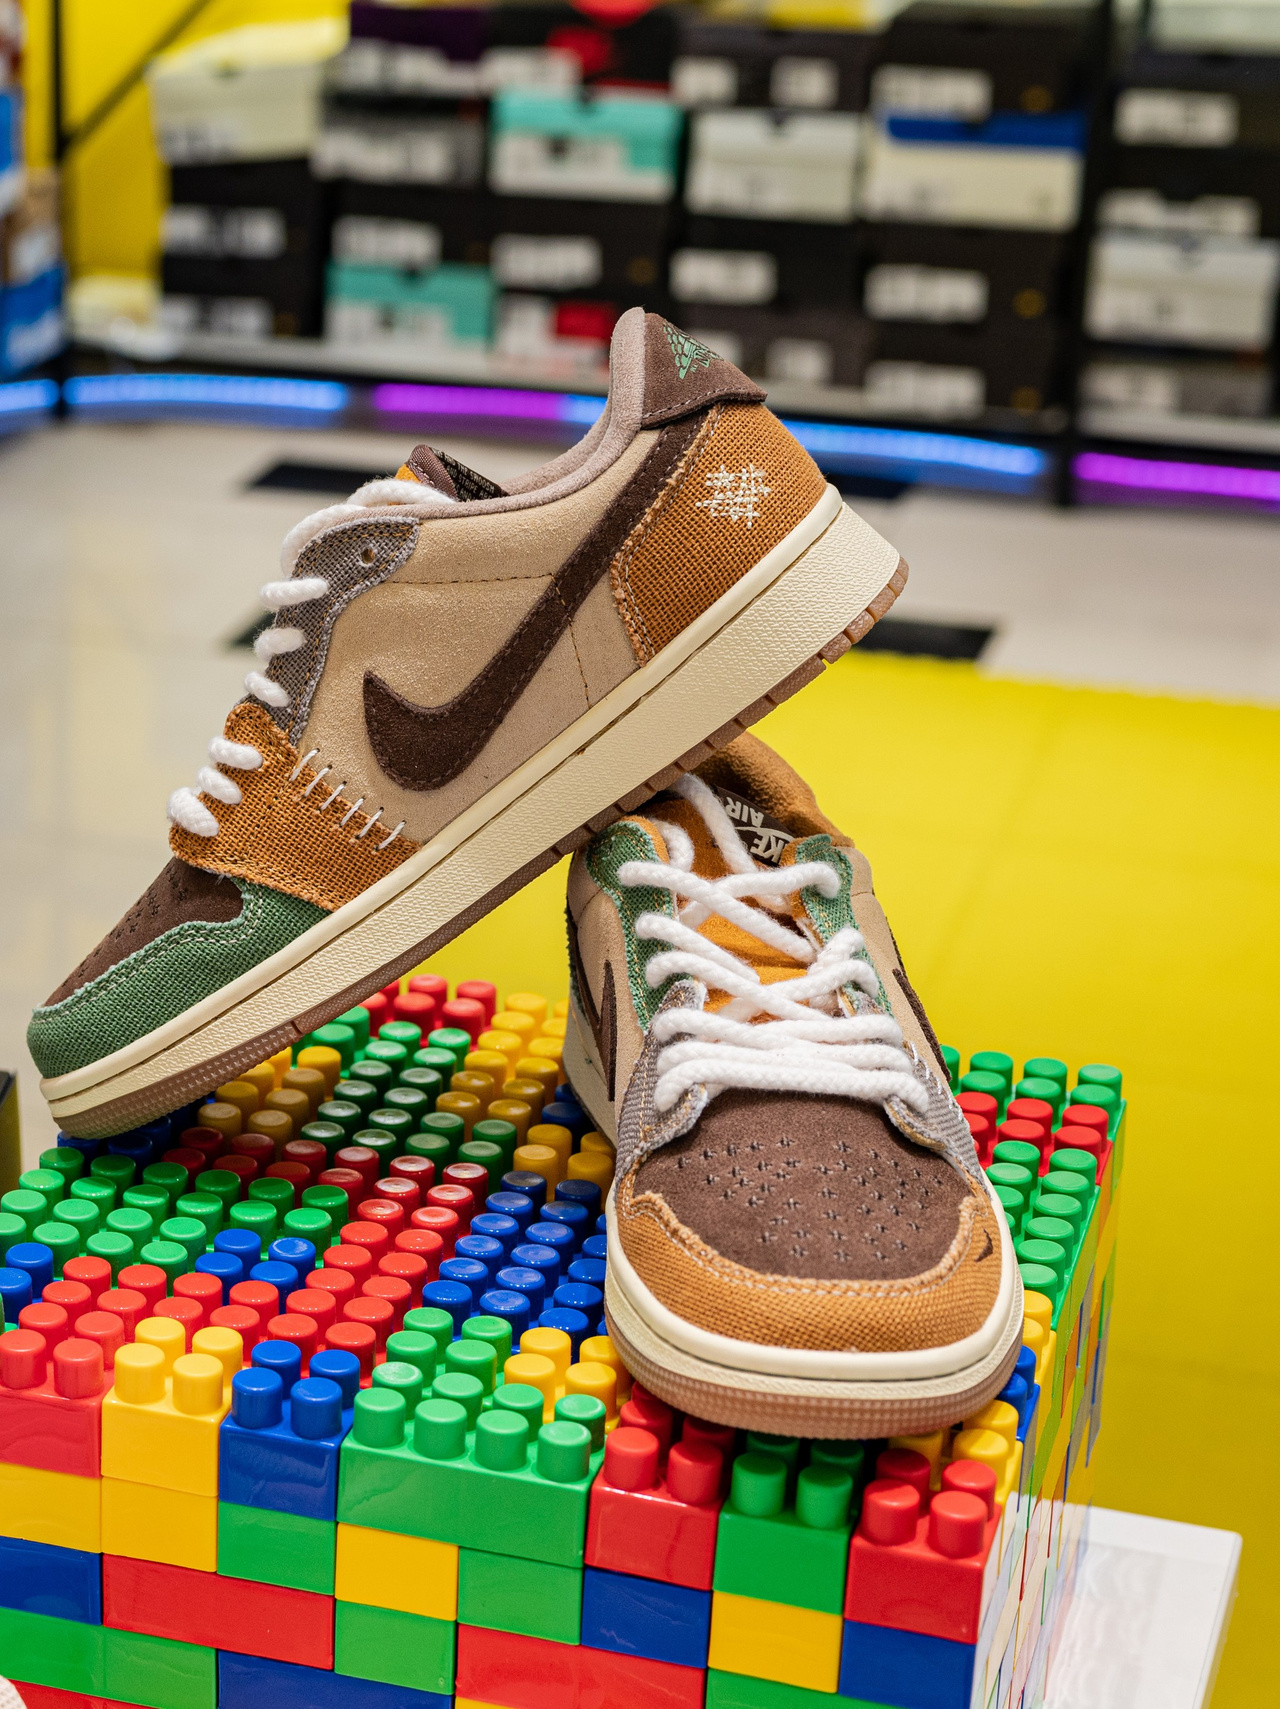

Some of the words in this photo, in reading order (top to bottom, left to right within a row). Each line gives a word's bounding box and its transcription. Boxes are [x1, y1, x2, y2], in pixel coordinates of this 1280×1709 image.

[459, 473, 479, 494] STRIPE
[469, 470, 495, 494] SWOOSH
[725, 796, 765, 828] AIR
[749, 831, 785, 865] KE
